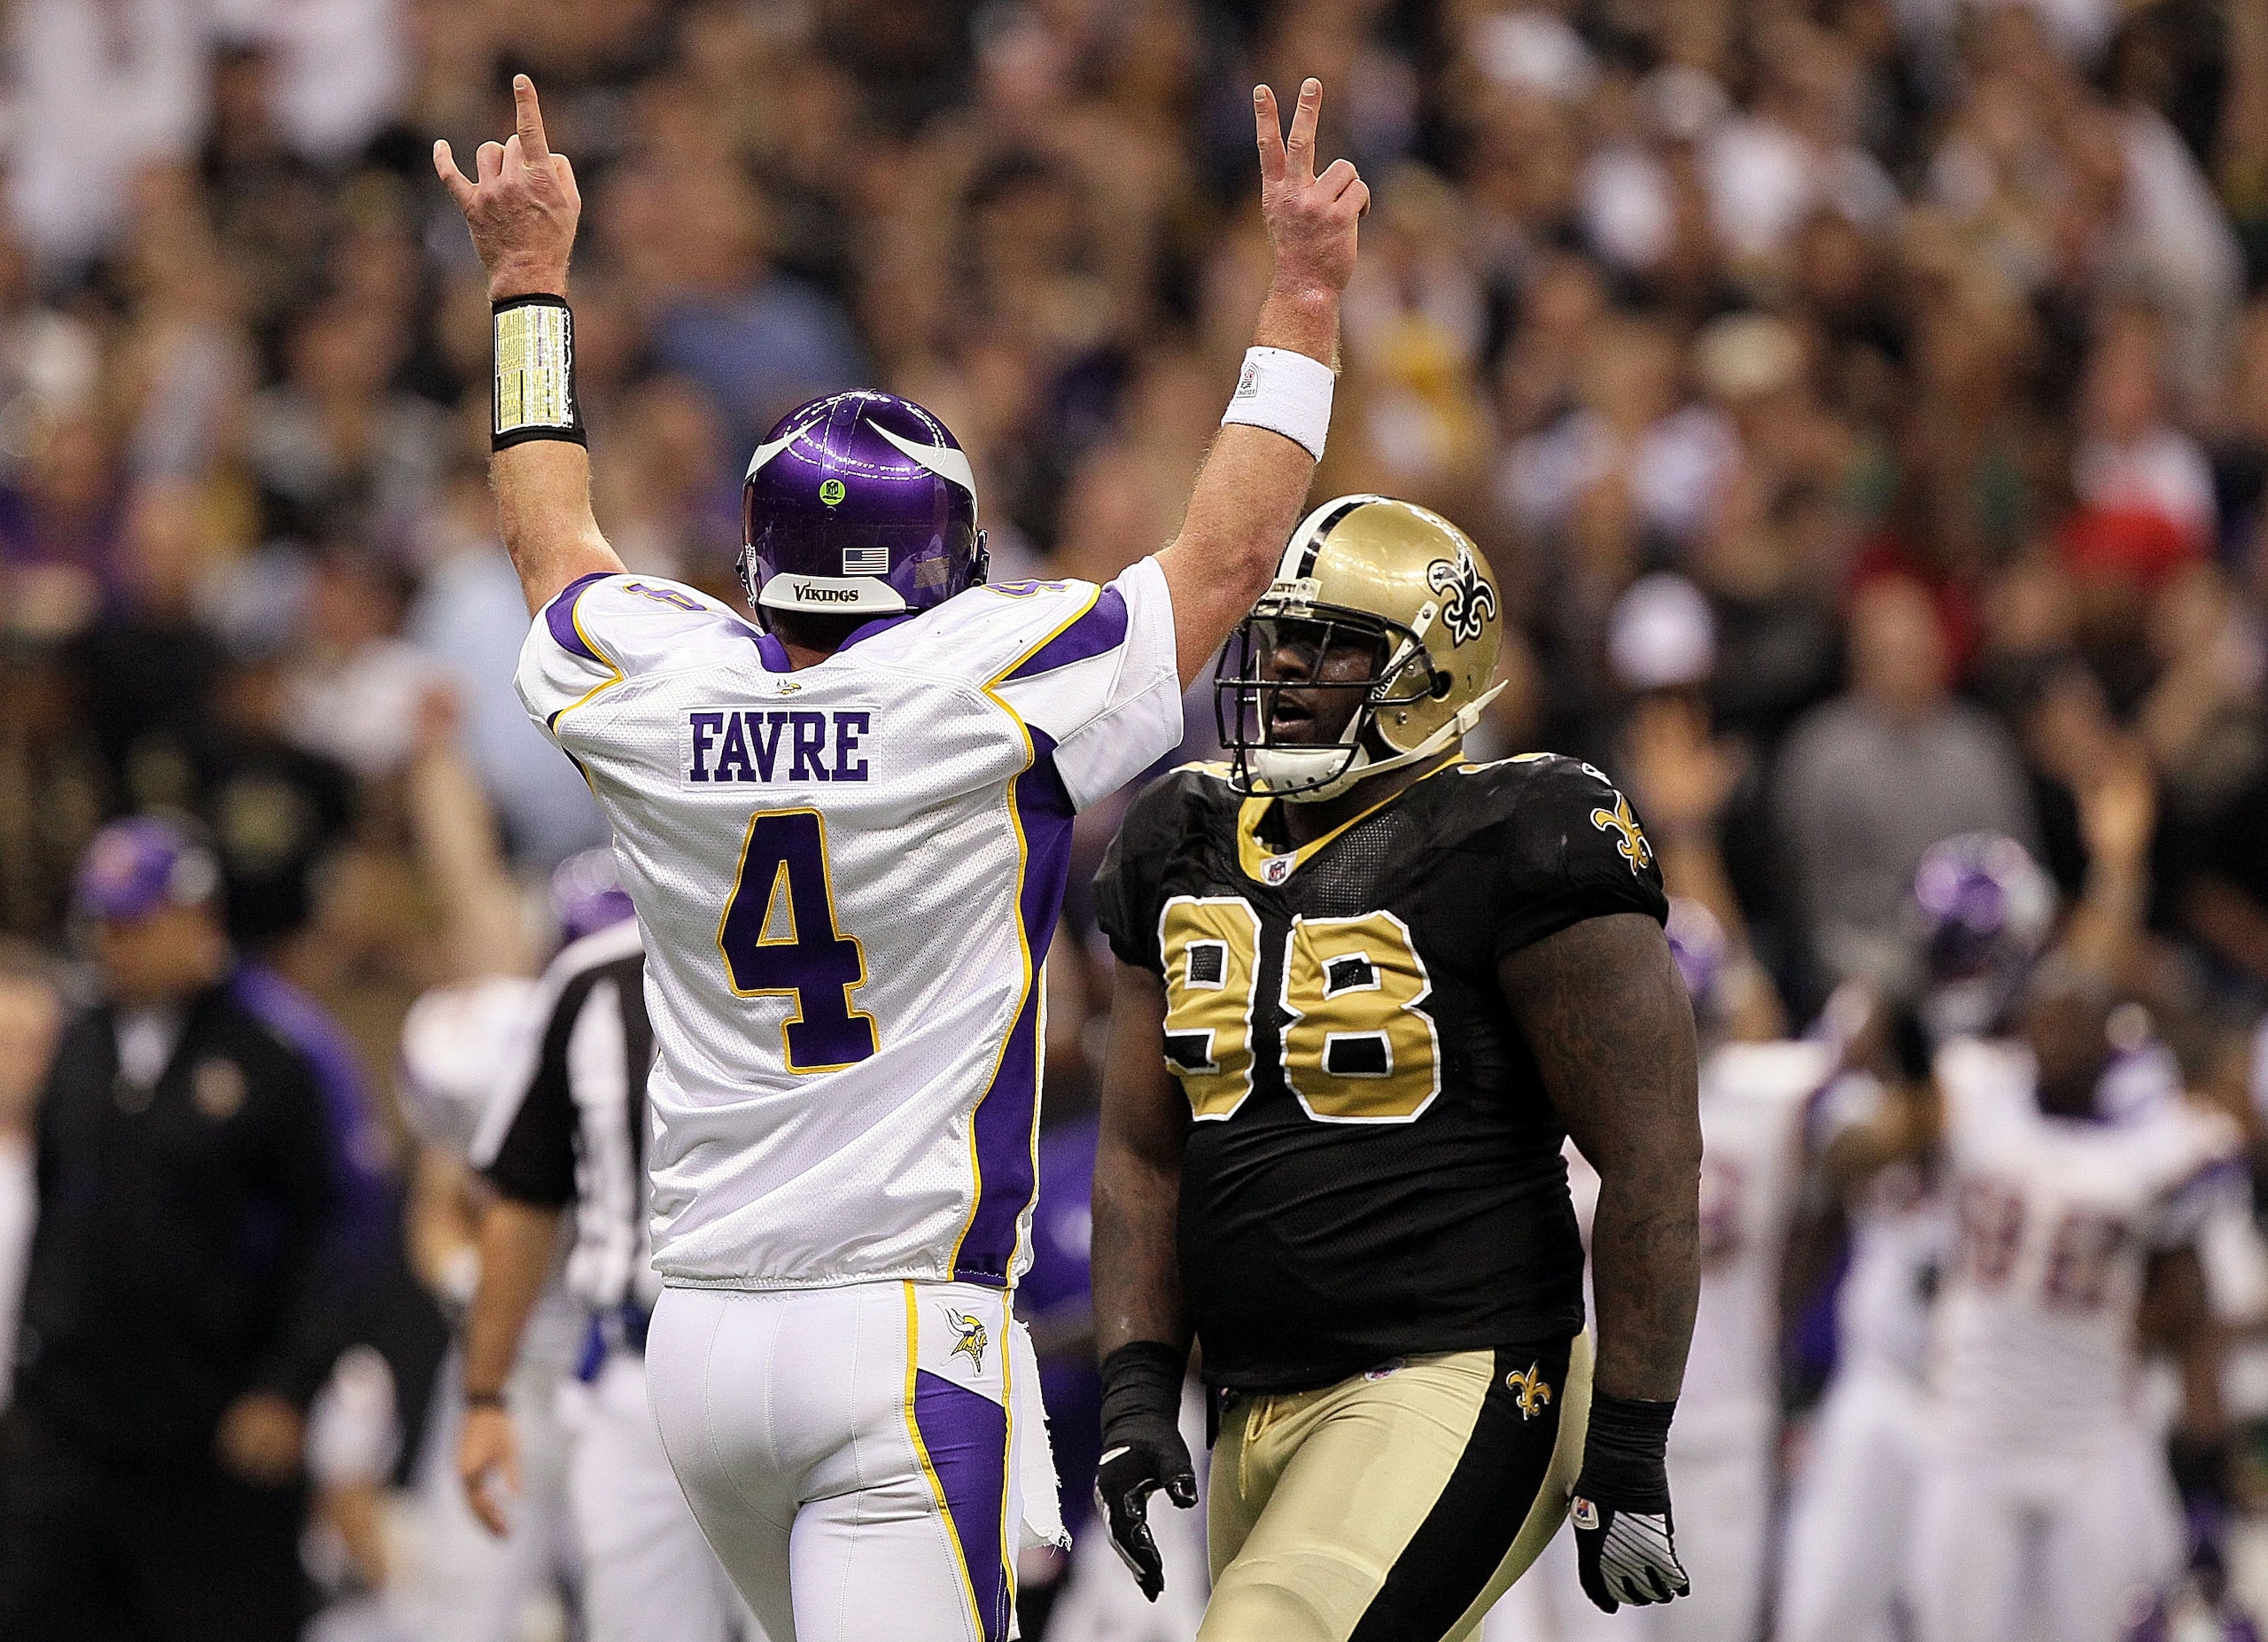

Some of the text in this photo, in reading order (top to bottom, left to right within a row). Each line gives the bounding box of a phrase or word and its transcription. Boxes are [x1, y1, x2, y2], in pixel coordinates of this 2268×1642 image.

[689, 712, 871, 782] FAVRE
[715, 806, 881, 1075] 4
[1157, 895, 1441, 1124] 98
